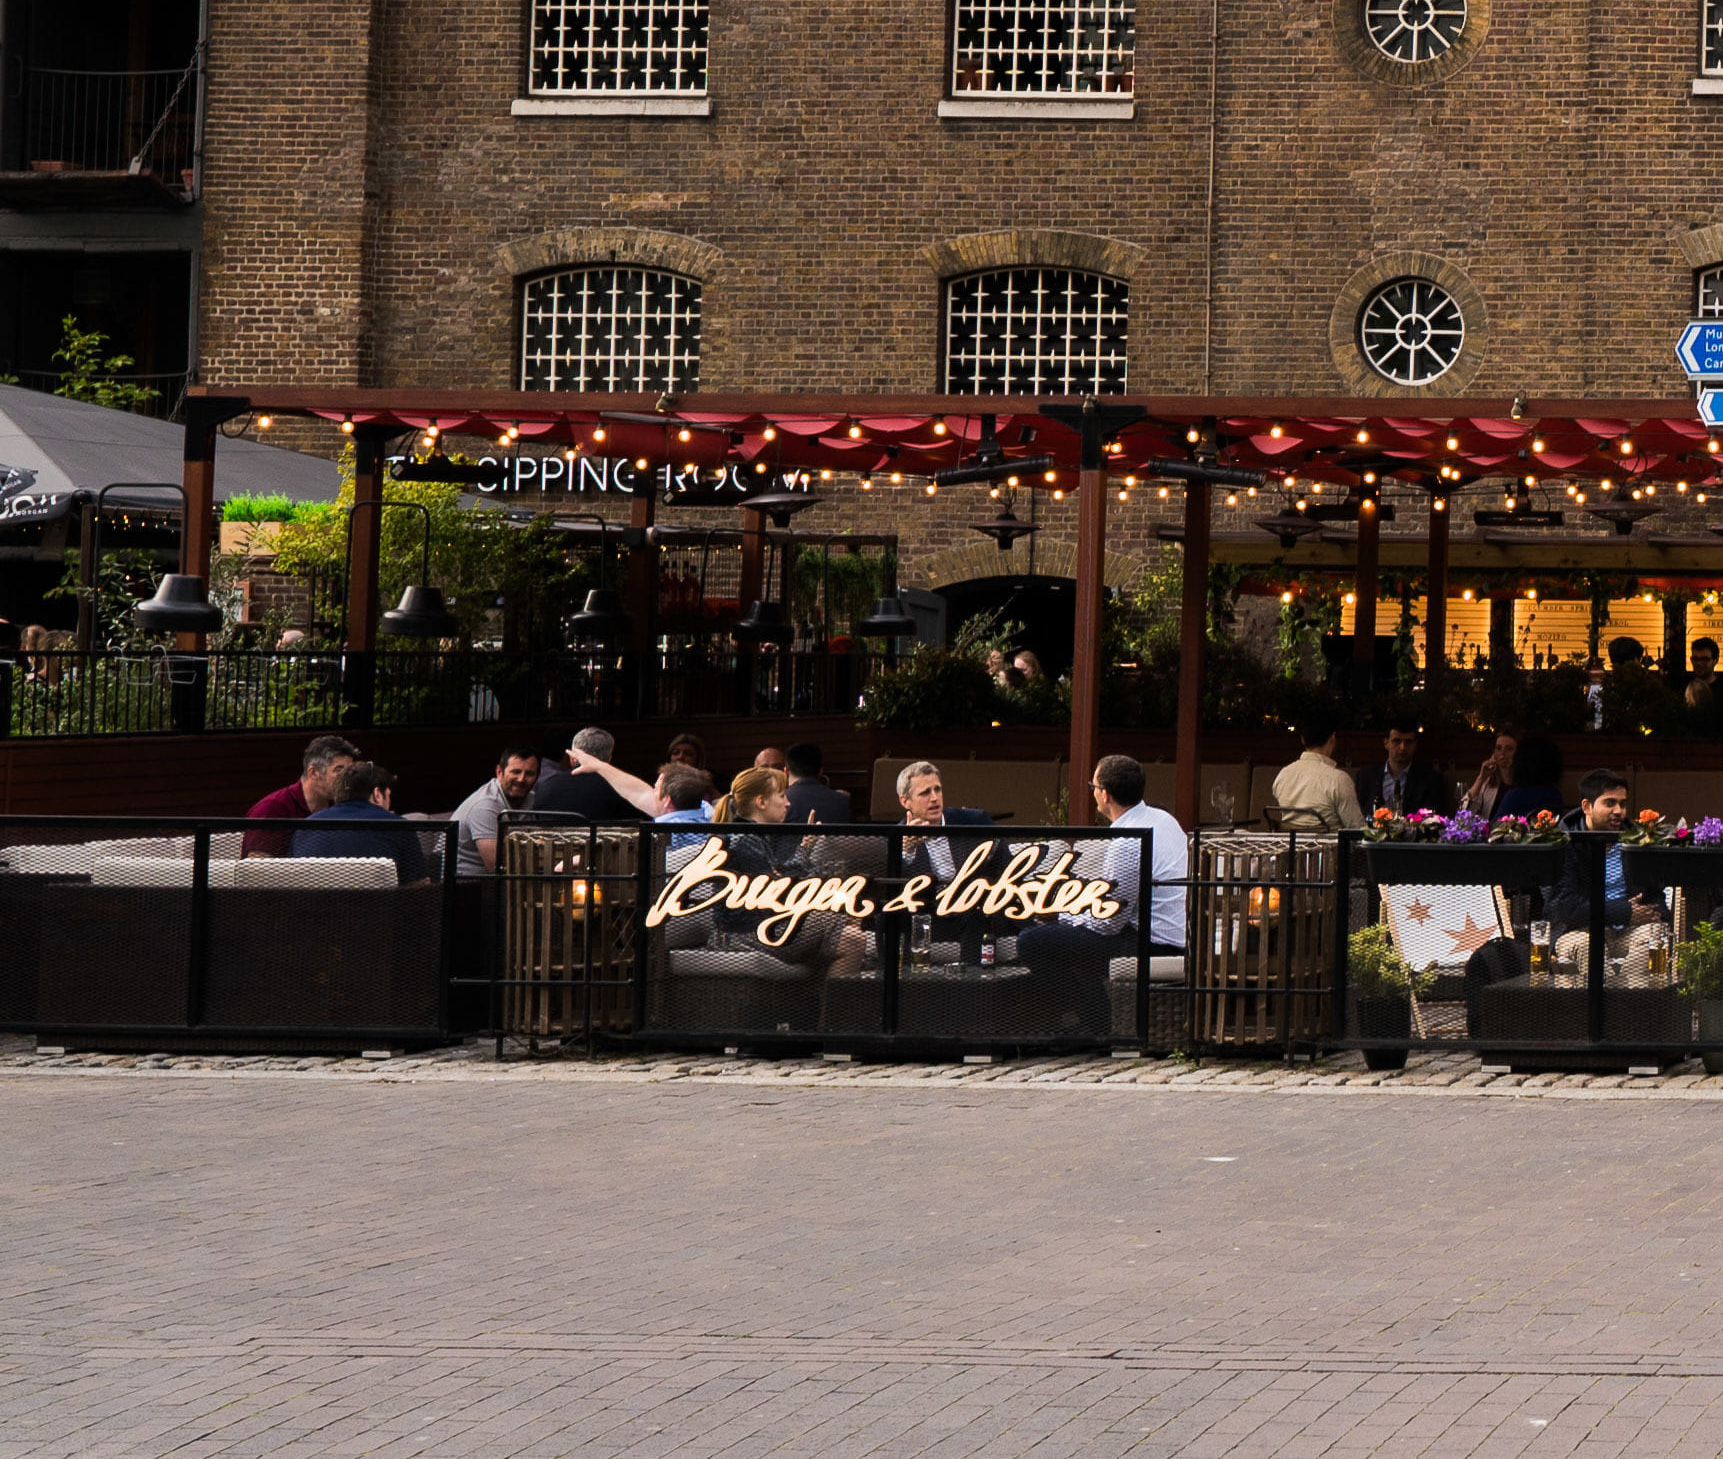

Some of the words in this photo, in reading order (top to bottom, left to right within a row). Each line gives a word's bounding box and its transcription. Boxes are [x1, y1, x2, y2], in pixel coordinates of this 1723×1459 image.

[645, 836, 876, 947] Burger
[882, 874, 933, 914] &
[936, 840, 1121, 920] lobster
